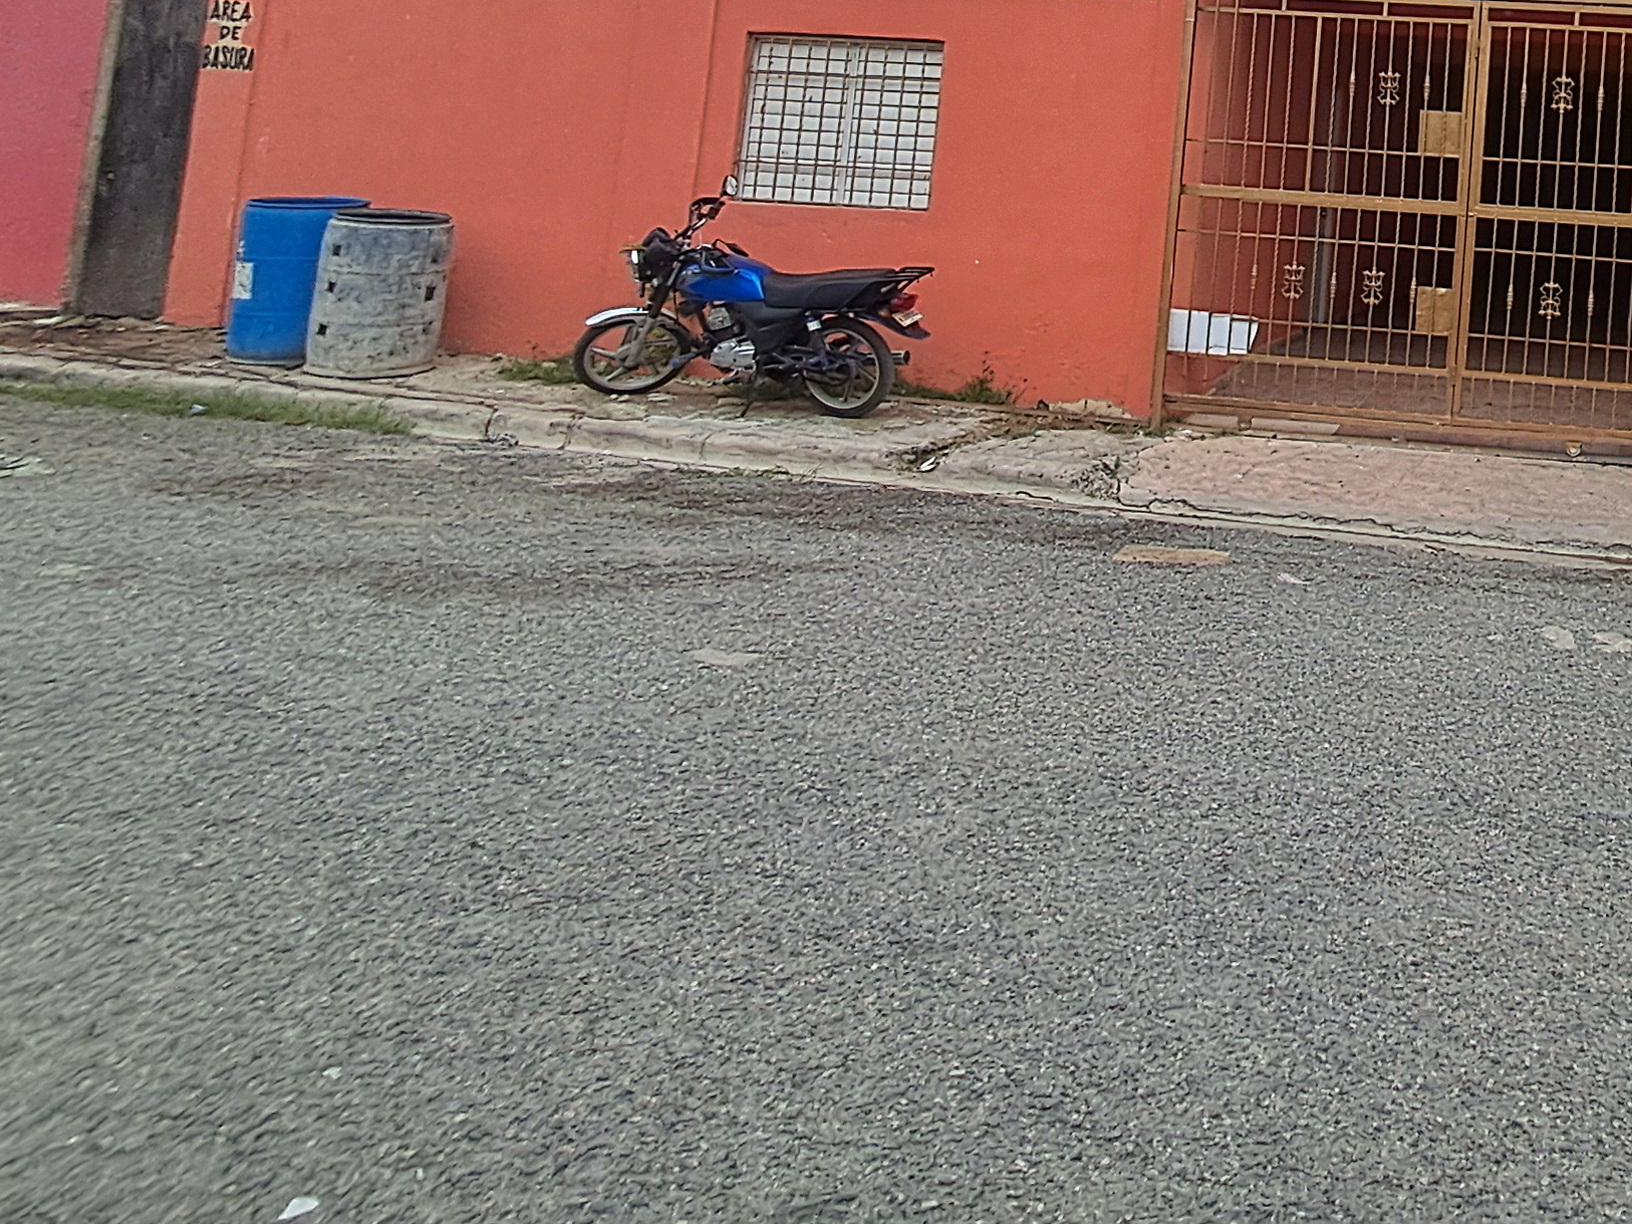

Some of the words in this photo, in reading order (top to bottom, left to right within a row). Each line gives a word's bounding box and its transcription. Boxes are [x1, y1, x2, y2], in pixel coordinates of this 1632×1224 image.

[210, 0, 252, 22] AREA
[220, 26, 242, 40] DE
[201, 44, 255, 71] BASURA
